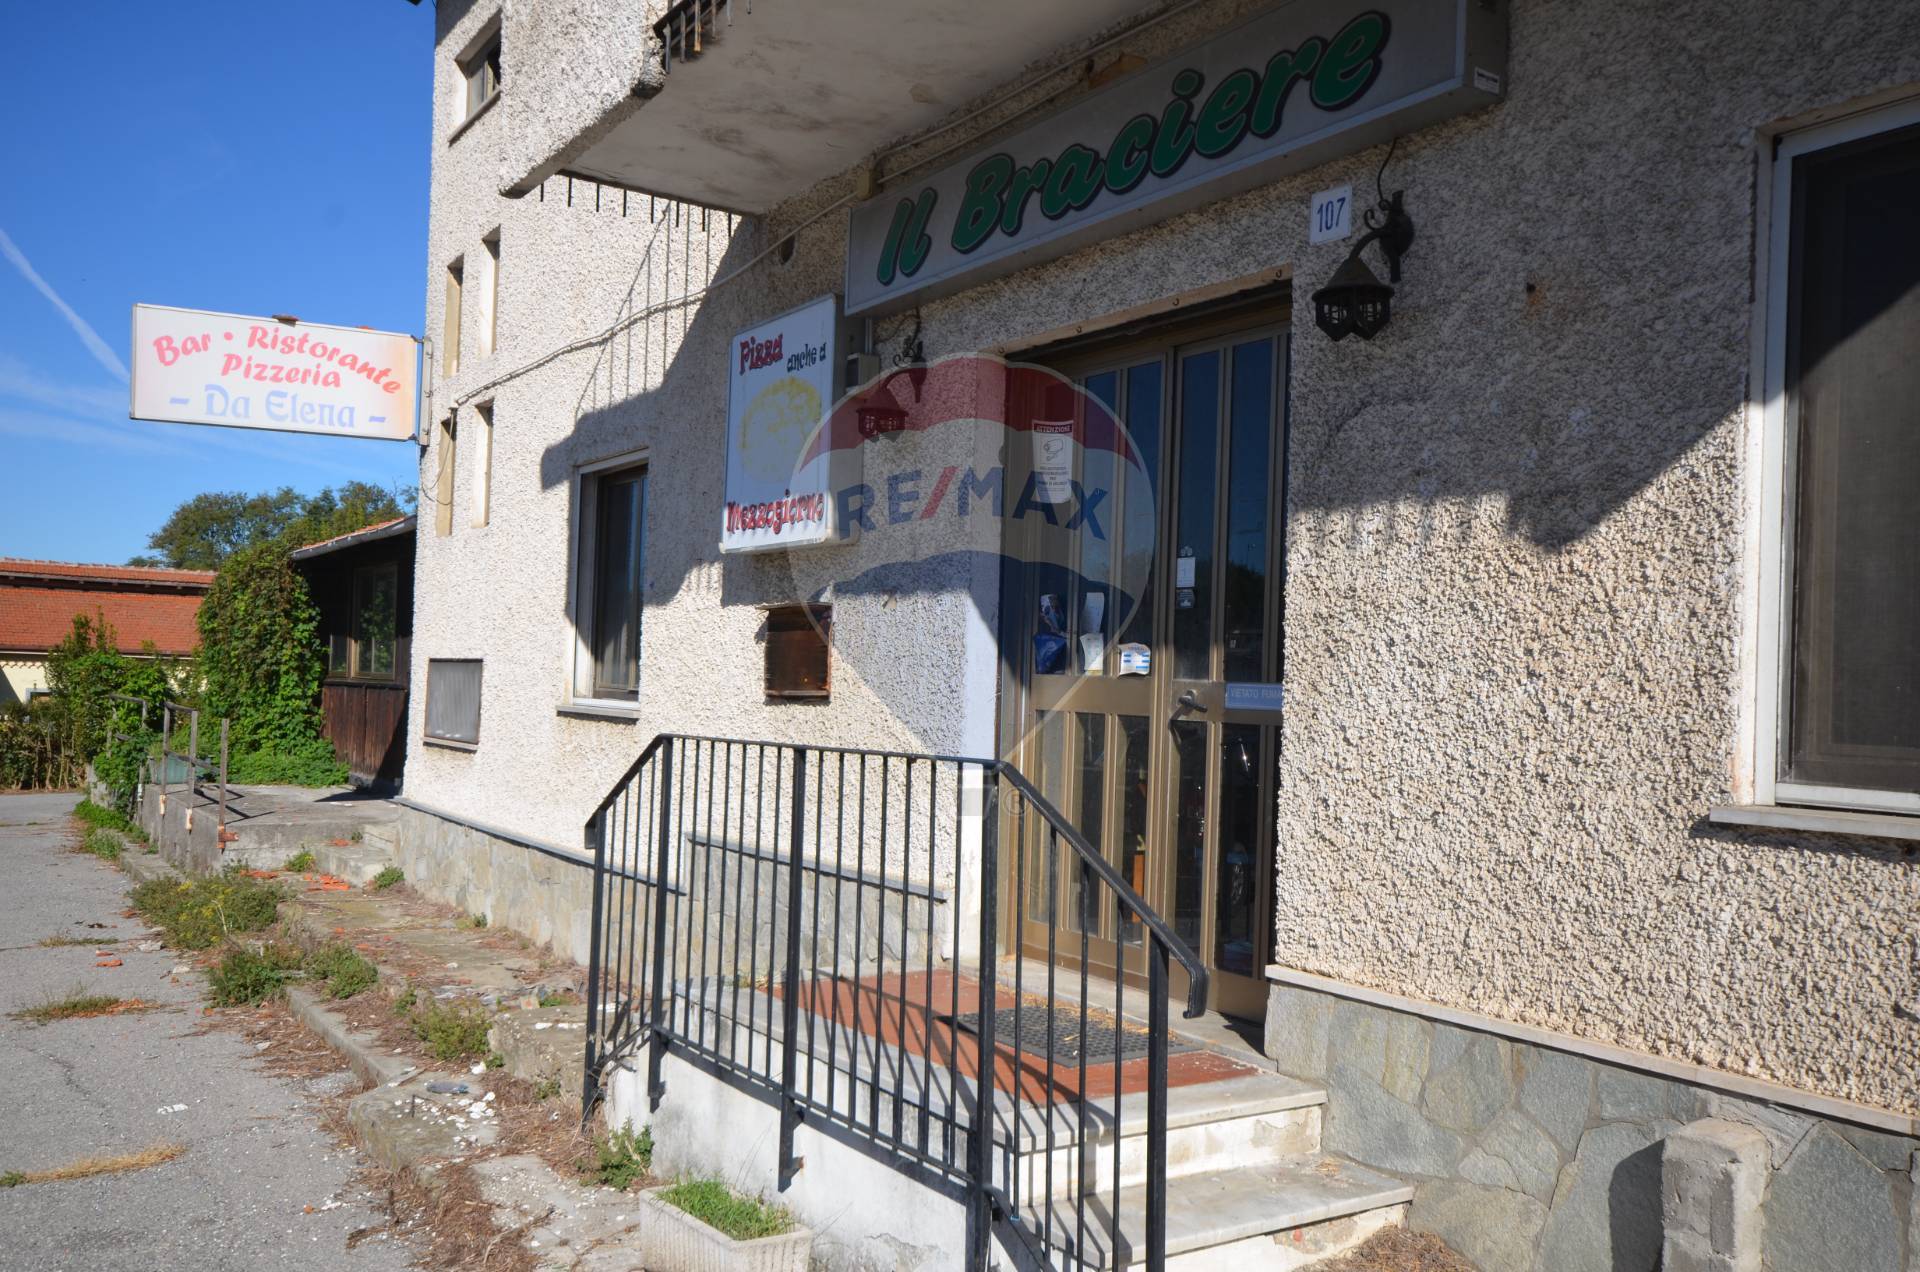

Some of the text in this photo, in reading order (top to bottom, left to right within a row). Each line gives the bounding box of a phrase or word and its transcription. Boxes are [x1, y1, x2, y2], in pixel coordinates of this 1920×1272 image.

[876, 10, 1391, 286] Il Braciere
[1317, 196, 1346, 233] 107
[152, 325, 402, 395] Bar Ristorante
[220, 353, 342, 389] Pizzeria
[739, 333, 827, 376] Pizza anche a
[204, 384, 356, 429] Da Elena
